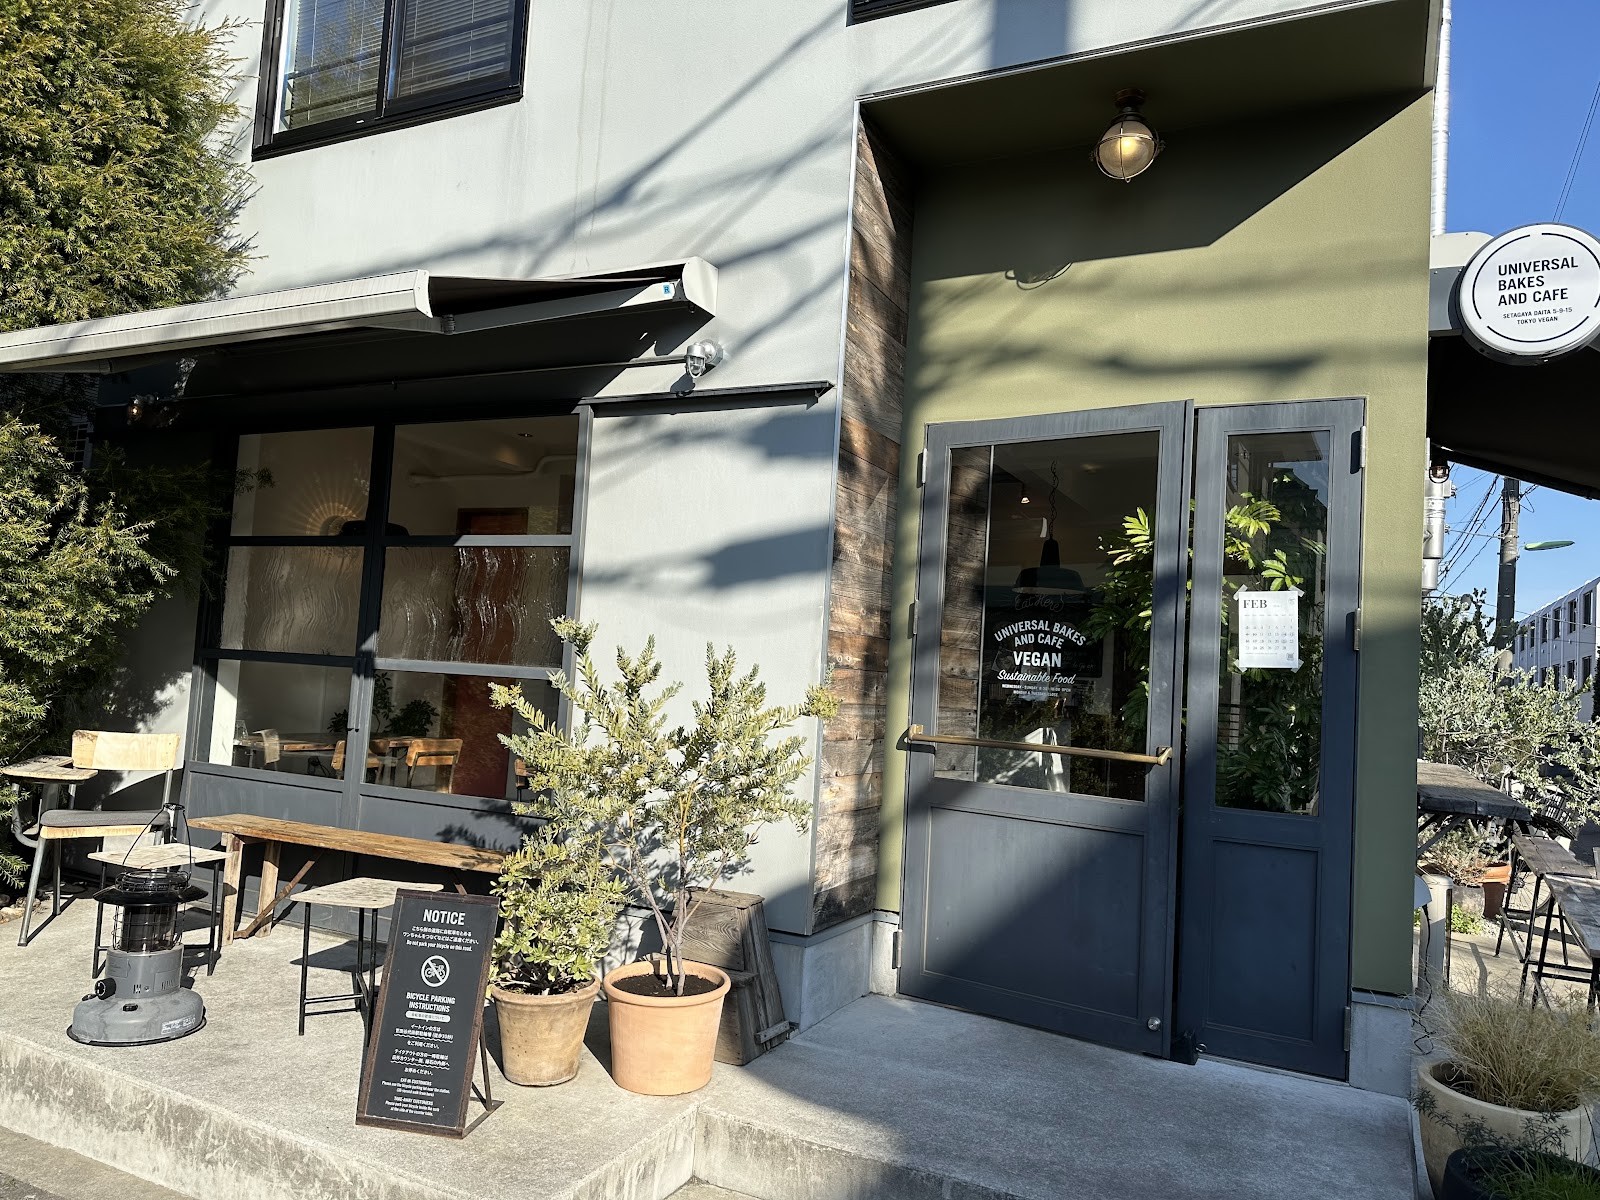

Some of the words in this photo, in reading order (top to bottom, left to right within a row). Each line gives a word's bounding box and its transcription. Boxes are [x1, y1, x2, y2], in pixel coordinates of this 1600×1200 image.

[1498, 257, 1578, 276] UNIVERSAL
[1498, 275, 1544, 291] BAKES
[1498, 293, 1527, 306] AND
[1533, 288, 1568, 302] CAFE
[1503, 311, 1532, 319] SETAGAYA
[1244, 600, 1267, 608] FEB
[994, 620, 1050, 641] UNIVERSAL
[1053, 622, 1086, 646] BAKES
[1014, 633, 1035, 647] AND
[1038, 633, 1064, 649] CAFE
[1013, 651, 1062, 667] VEGAN
[997, 670, 1050, 682] Sustainable
[1052, 672, 1076, 684] Food
[423, 909, 465, 925] NOTICE
[406, 992, 430, 1001] BICYCLE
[430, 995, 455, 1004] PARKING
[409, 1001, 450, 1012] INSTRUCTIONS
